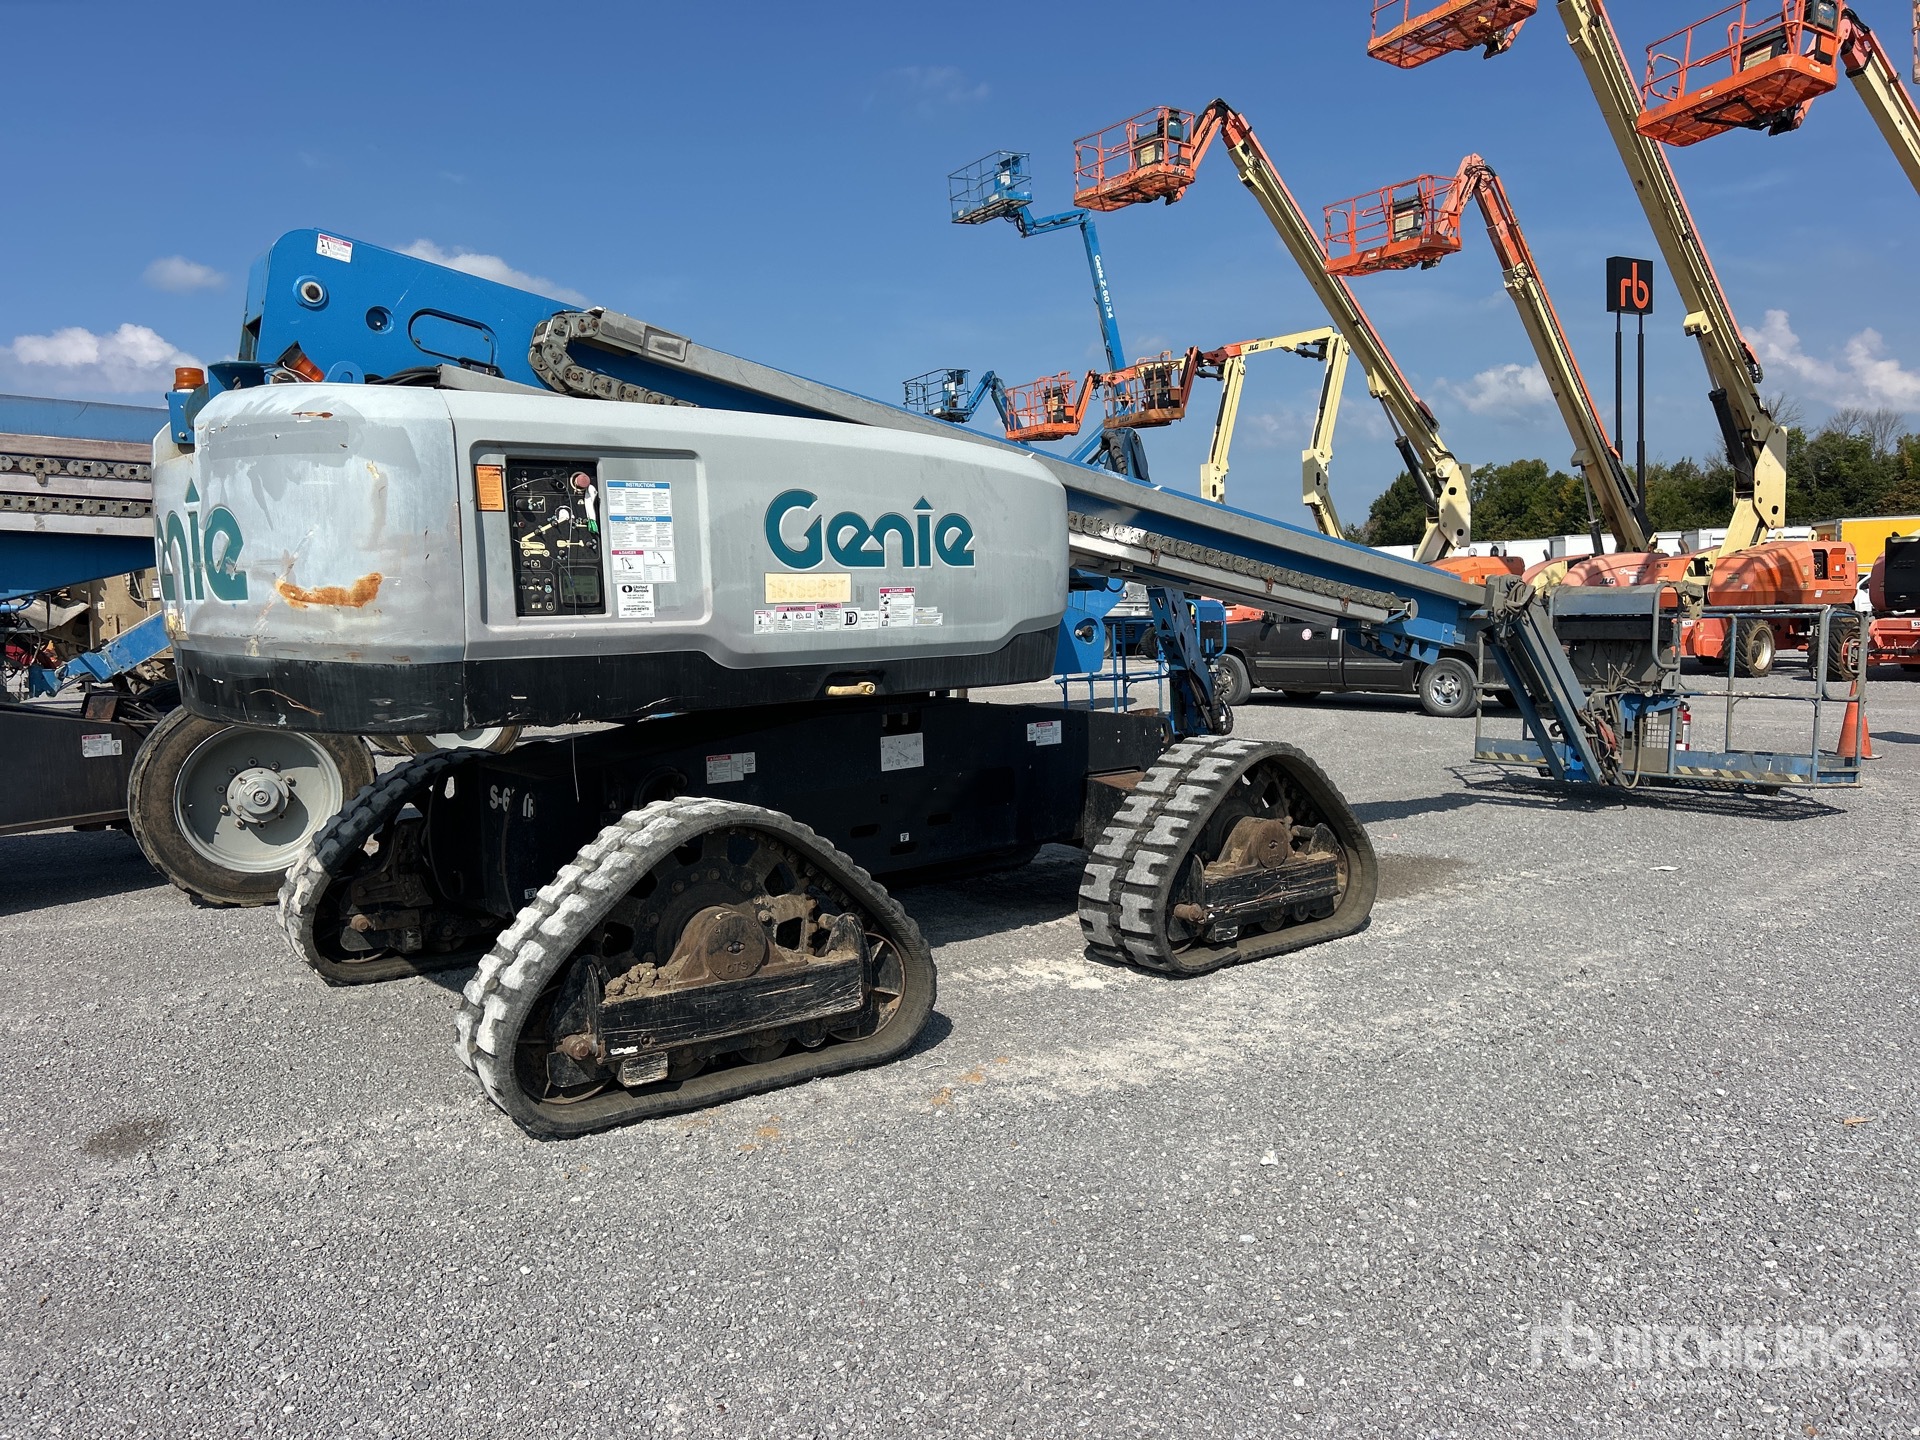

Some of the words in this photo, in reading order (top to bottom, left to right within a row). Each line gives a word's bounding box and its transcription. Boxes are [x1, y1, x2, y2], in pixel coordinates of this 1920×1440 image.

[1094, 254, 1104, 279] Genie
[1099, 279, 1114, 319] Z-60/34
[1620, 261, 1650, 310] rb
[1248, 343, 1260, 352] JLG
[764, 488, 976, 570] Genie
[1599, 577, 1615, 585] JLG
[489, 784, 516, 813] S-6
